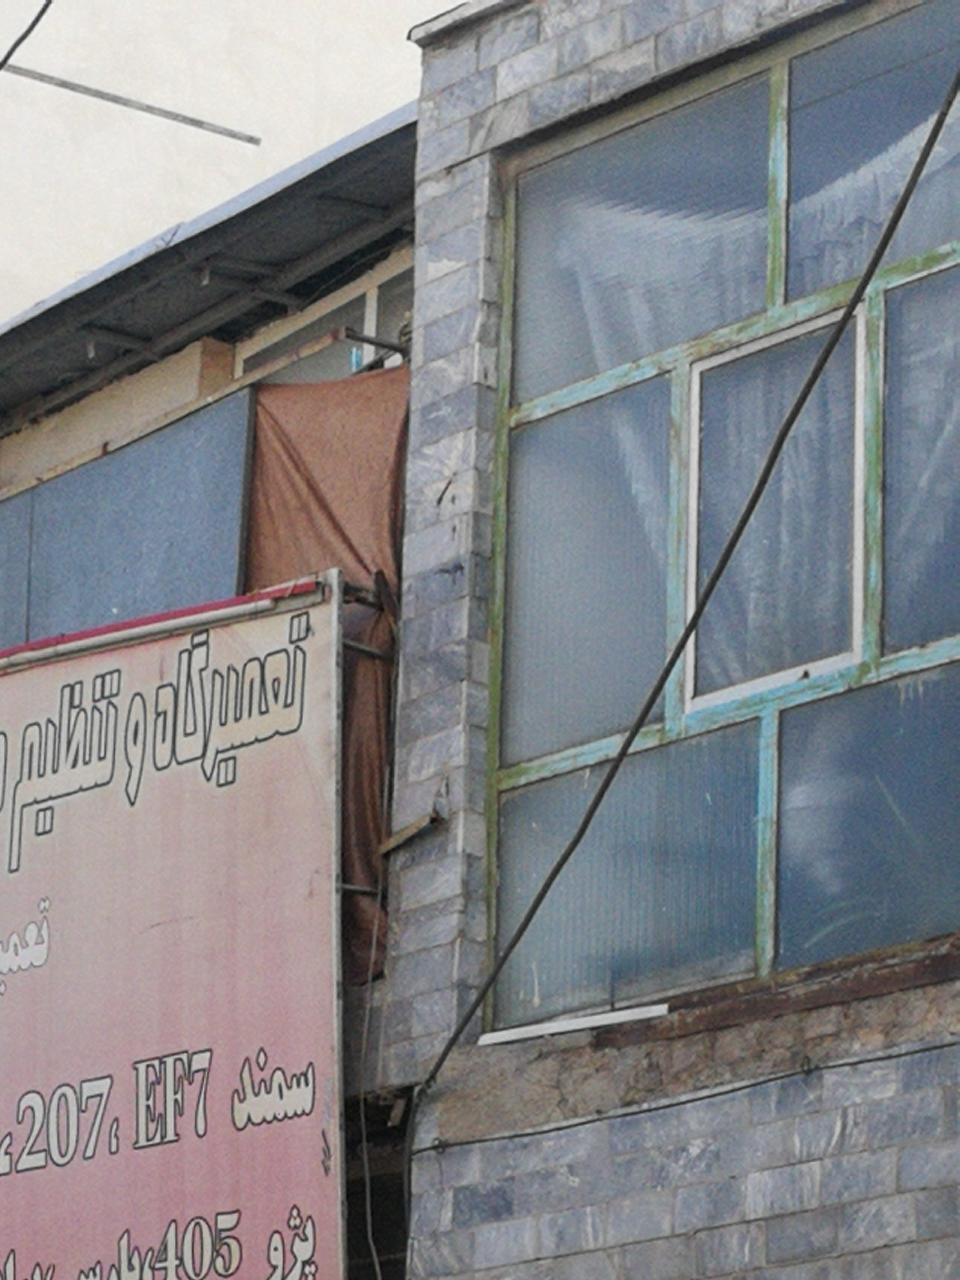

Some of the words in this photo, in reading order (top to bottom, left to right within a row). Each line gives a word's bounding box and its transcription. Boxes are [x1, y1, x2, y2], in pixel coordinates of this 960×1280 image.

[125, 692, 148, 808] و
[152, 612, 309, 788] تعمیرگاه
[8, 668, 121, 874] تنظیم
[133, 1048, 213, 1150] EF7
[231, 1047, 317, 1132] سمند
